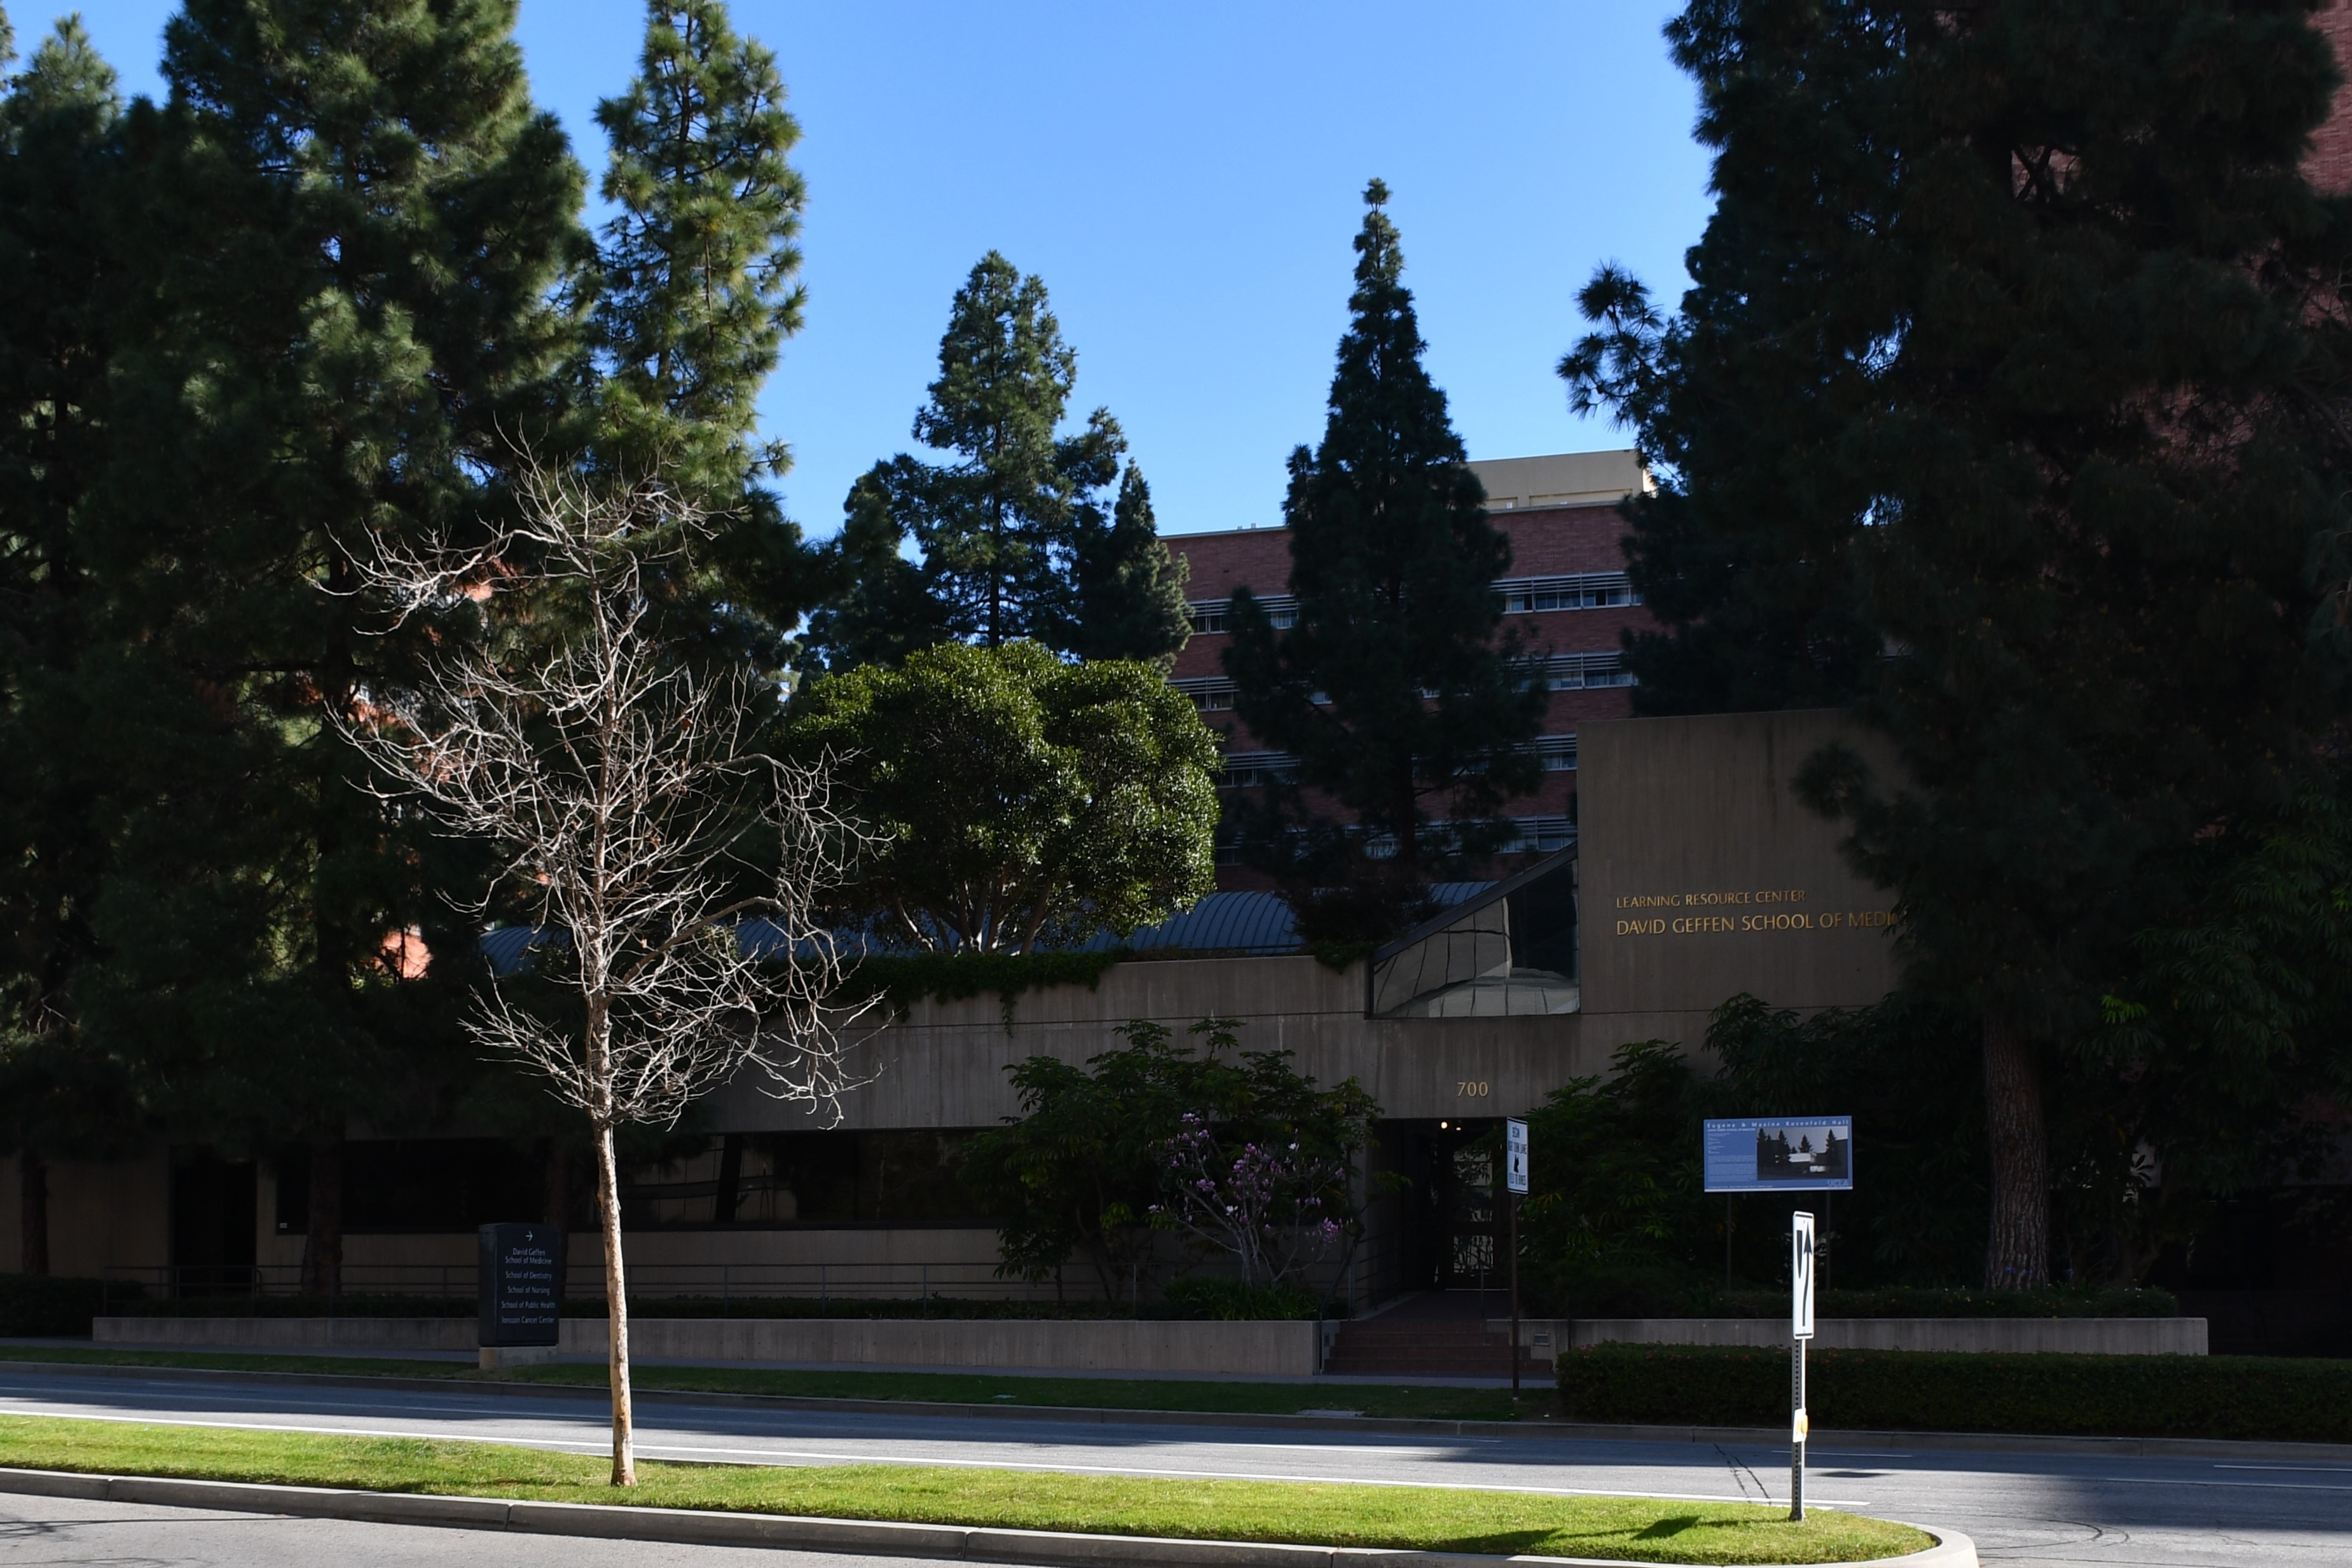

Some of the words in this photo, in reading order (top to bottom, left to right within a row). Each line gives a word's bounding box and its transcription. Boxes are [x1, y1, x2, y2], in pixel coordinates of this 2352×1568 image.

[1616, 894, 1680, 909] LEARNING
[1685, 891, 1751, 907] RESOURCE
[1755, 890, 1806, 904] CENTER
[1617, 918, 1666, 936] DAVID
[1672, 916, 1735, 934] GEFFEN
[1742, 913, 1814, 931] SCHOOL
[1819, 912, 1842, 928] OF
[1457, 1082, 1489, 1097] 700
[512, 1247, 528, 1256] David
[528, 1248, 546, 1256] Geffen
[505, 1255, 522, 1264] School
[523, 1256, 529, 1264] of
[530, 1256, 552, 1265] Medicine
[505, 1270, 522, 1279] School
[523, 1271, 529, 1279] of
[530, 1272, 552, 1281] Dentistry
[507, 1285, 524, 1293] School
[525, 1286, 530, 1294] of
[532, 1286, 550, 1296] Nursing
[501, 1300, 518, 1309] School
[521, 1316, 538, 1324] Cancer
[539, 1316, 555, 1324] Center
